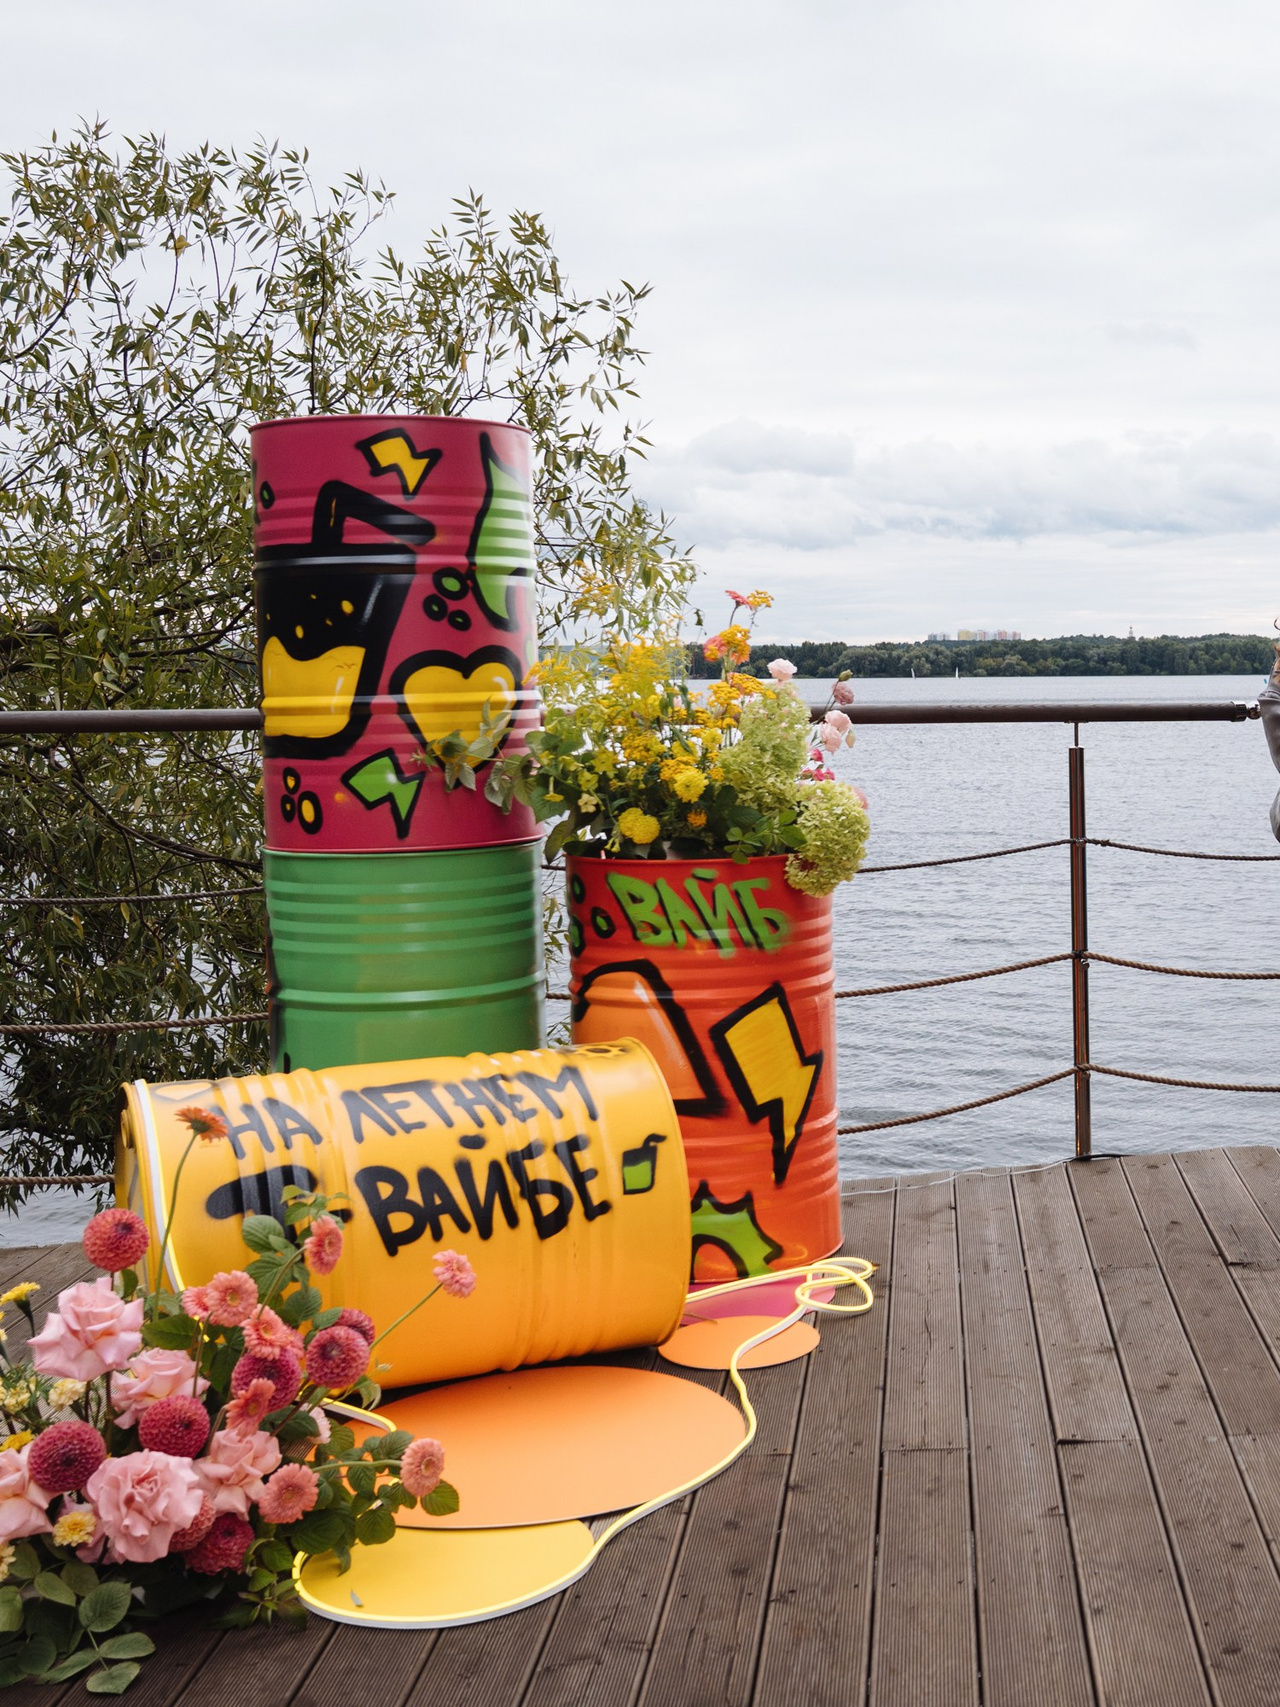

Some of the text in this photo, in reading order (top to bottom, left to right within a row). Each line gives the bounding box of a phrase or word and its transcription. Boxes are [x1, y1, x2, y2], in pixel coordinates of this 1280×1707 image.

[607, 868, 790, 958] ВАЙБ
[211, 1067, 599, 1160] НА ЛЕТНЕМ
[354, 1134, 612, 1257] ВАЙБЕ
